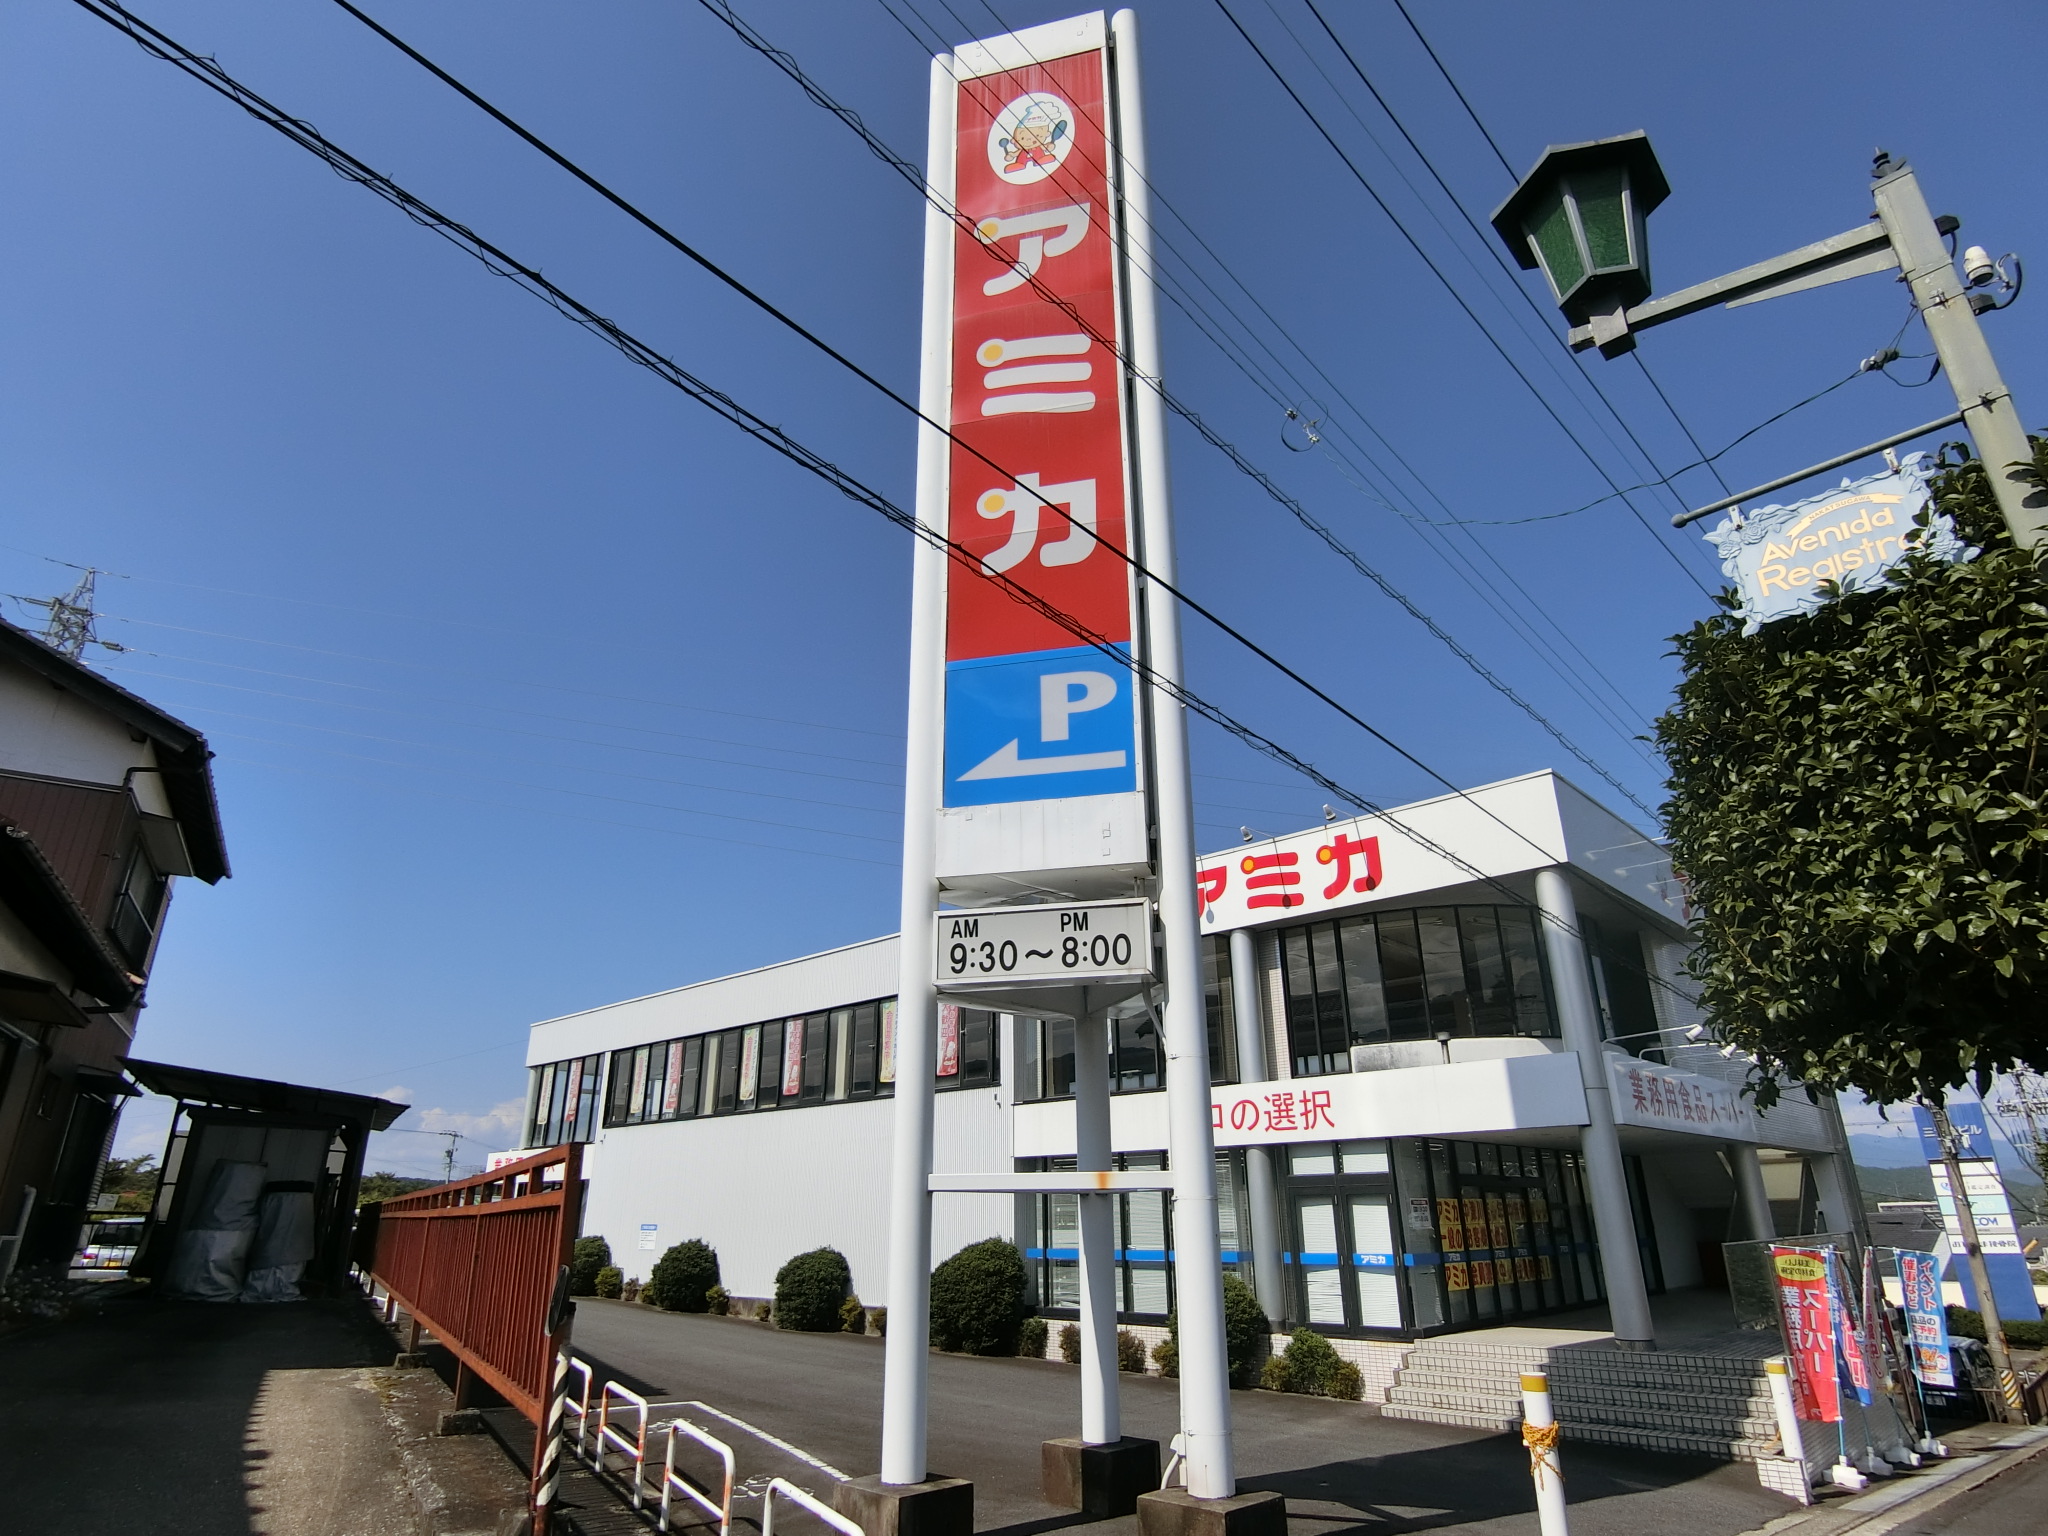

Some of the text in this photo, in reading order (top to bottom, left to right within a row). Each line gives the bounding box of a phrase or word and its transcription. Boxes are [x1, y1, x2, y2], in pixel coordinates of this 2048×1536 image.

[974, 202, 1097, 576] アミカ
[1760, 506, 1895, 567] Avenida
[1040, 670, 1117, 742] P
[950, 911, 1089, 938] AM PM
[1360, 1254, 1386, 1264] アミカ
[1901, 1257, 1919, 1310] 催事など
[1918, 1259, 1937, 1311] イベント
